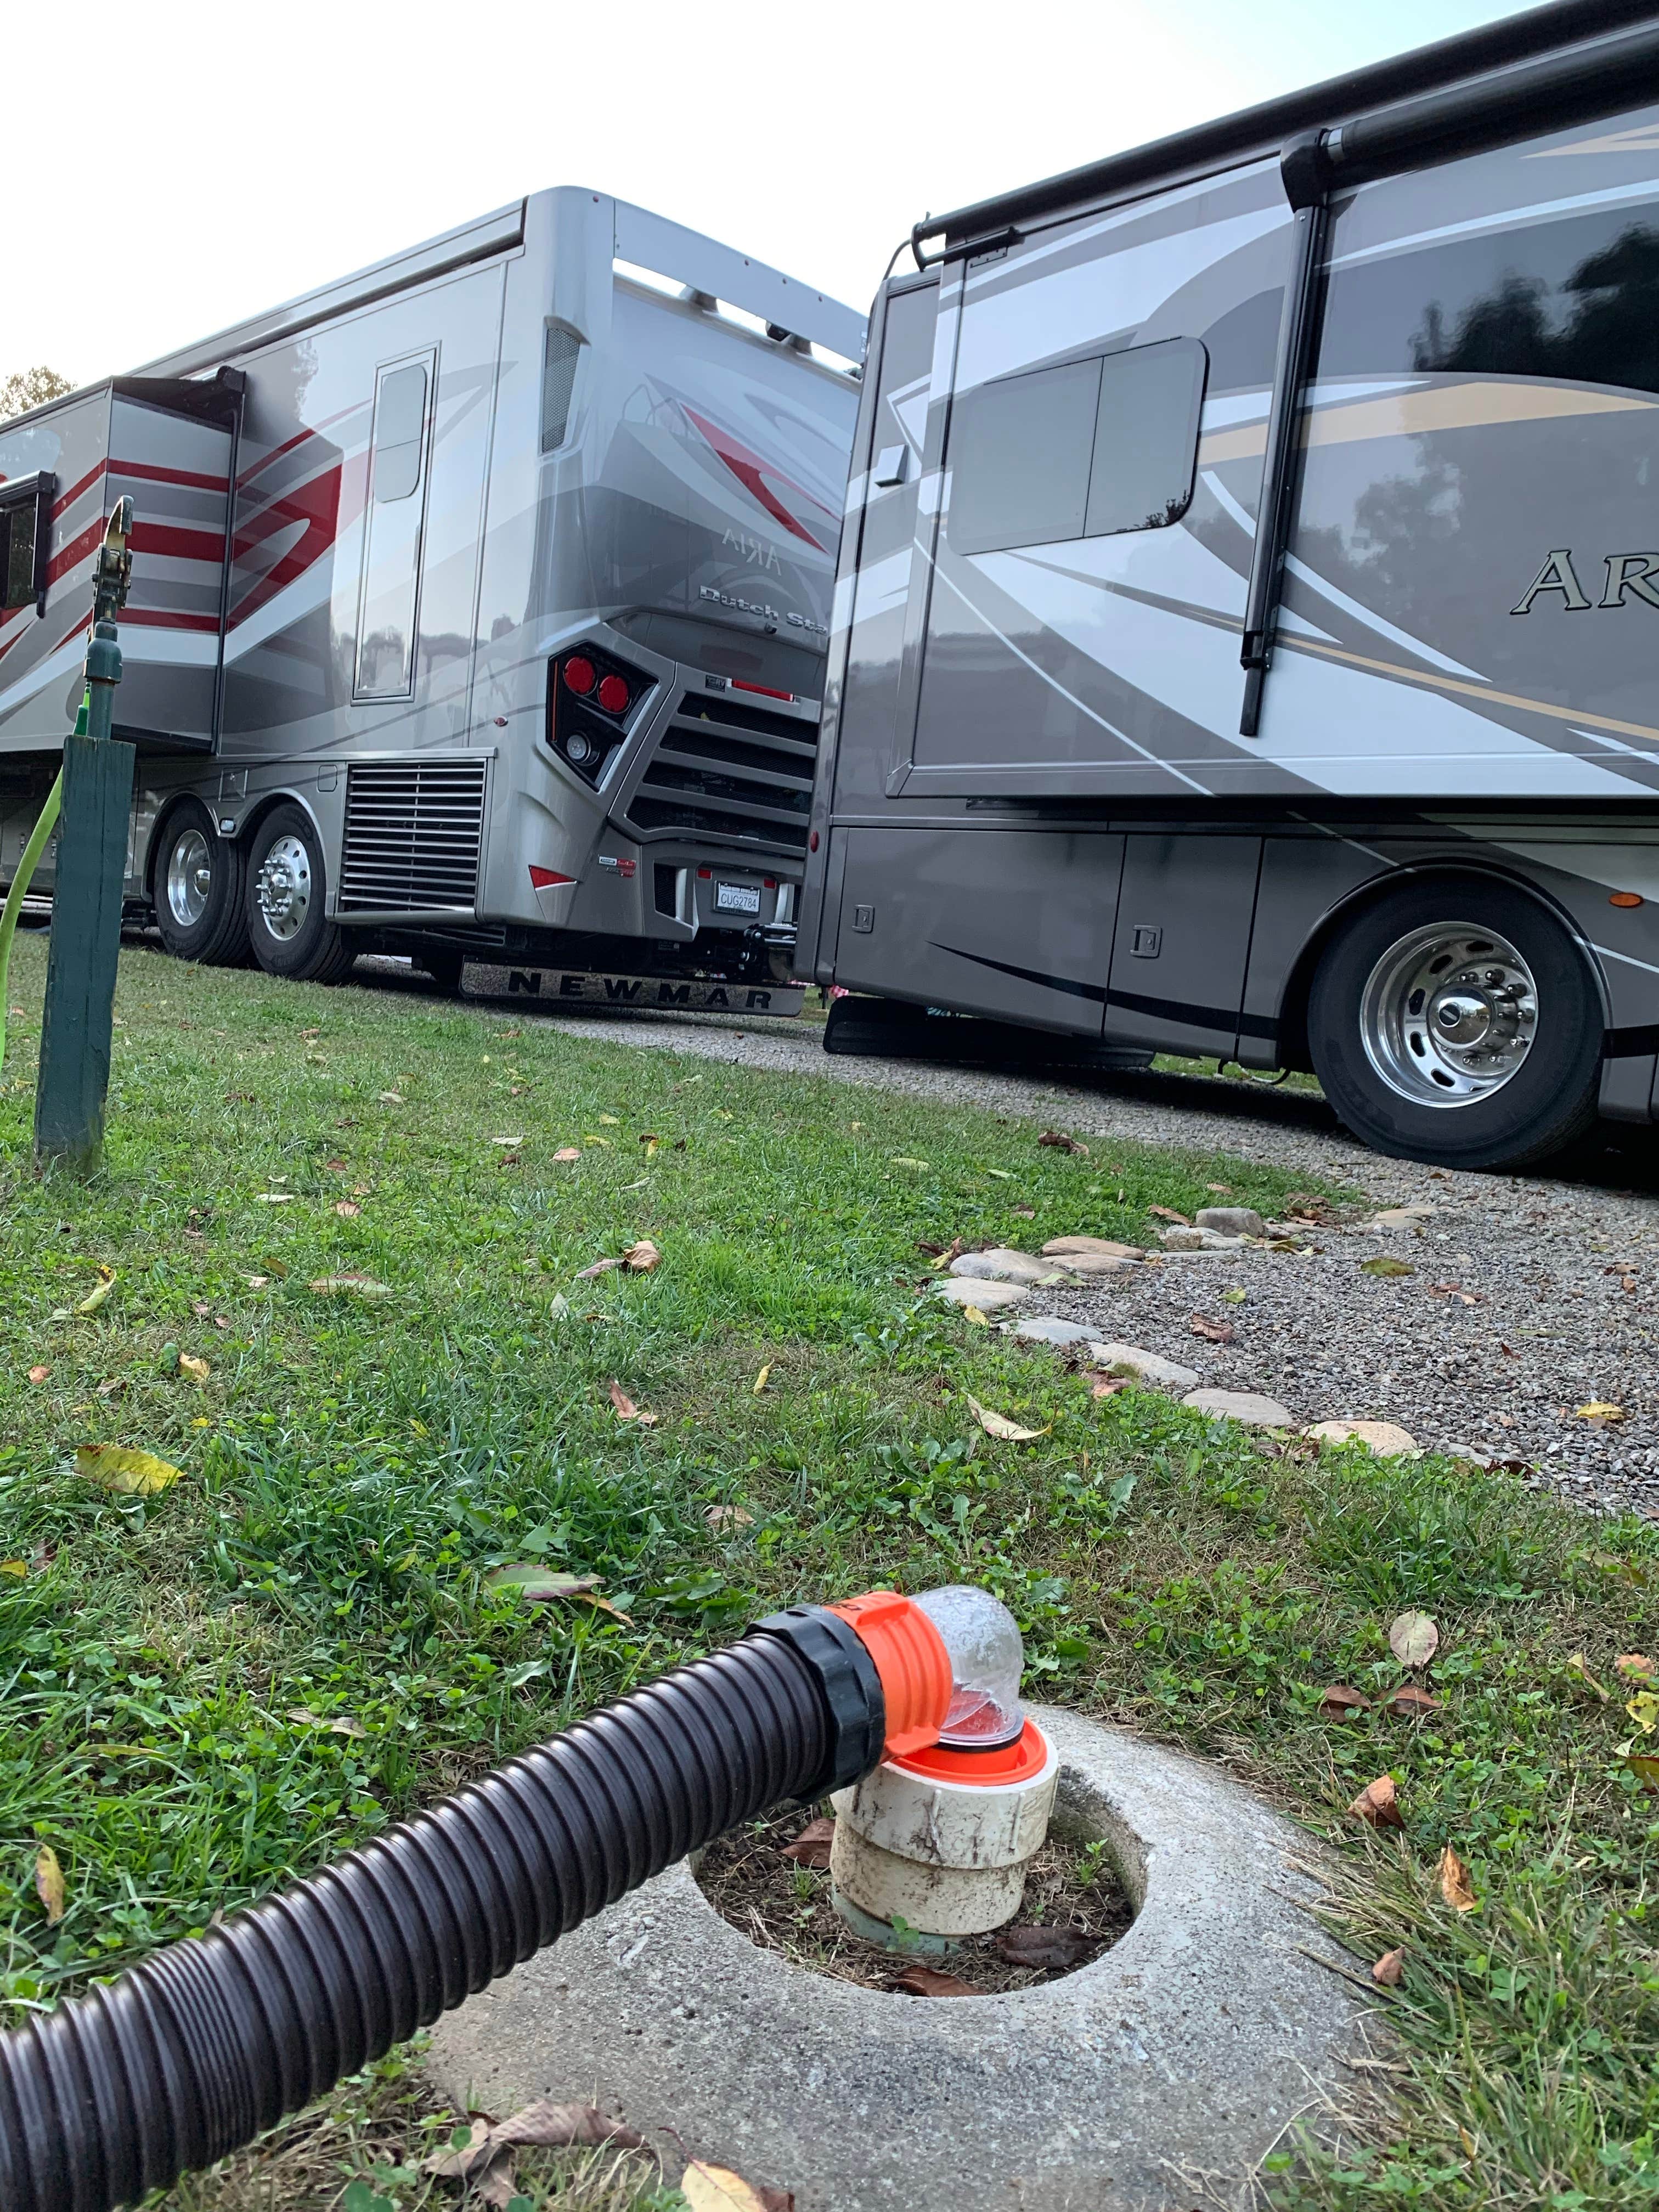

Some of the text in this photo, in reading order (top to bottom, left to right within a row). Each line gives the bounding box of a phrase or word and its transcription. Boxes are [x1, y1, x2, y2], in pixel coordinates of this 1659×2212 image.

[1509, 549, 1659, 616] AR
[699, 585, 779, 621] Dutch
[721, 893, 757, 909] CUG2784
[508, 970, 771, 1009] NEWMAR
